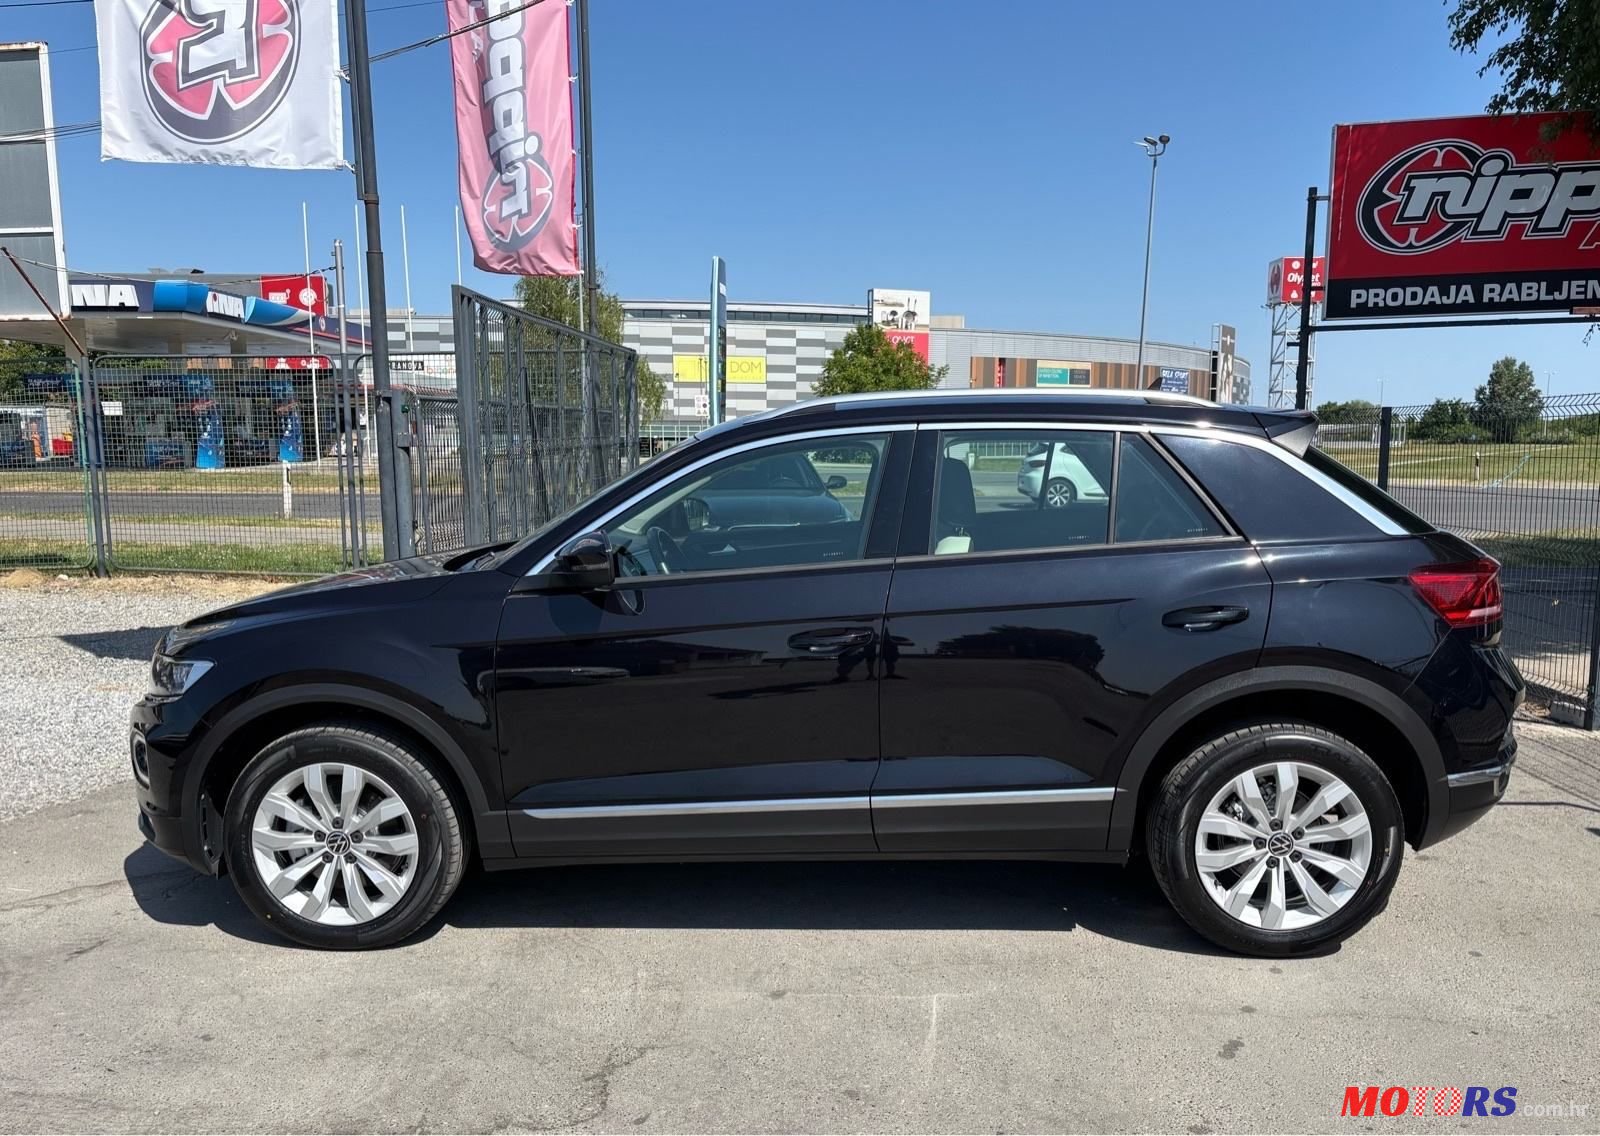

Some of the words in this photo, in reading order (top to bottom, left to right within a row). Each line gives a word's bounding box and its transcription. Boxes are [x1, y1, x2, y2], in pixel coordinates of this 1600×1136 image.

[71, 284, 140, 308] NA
[1350, 283, 1475, 309] PRODAJA
[730, 361, 762, 373] DOM
